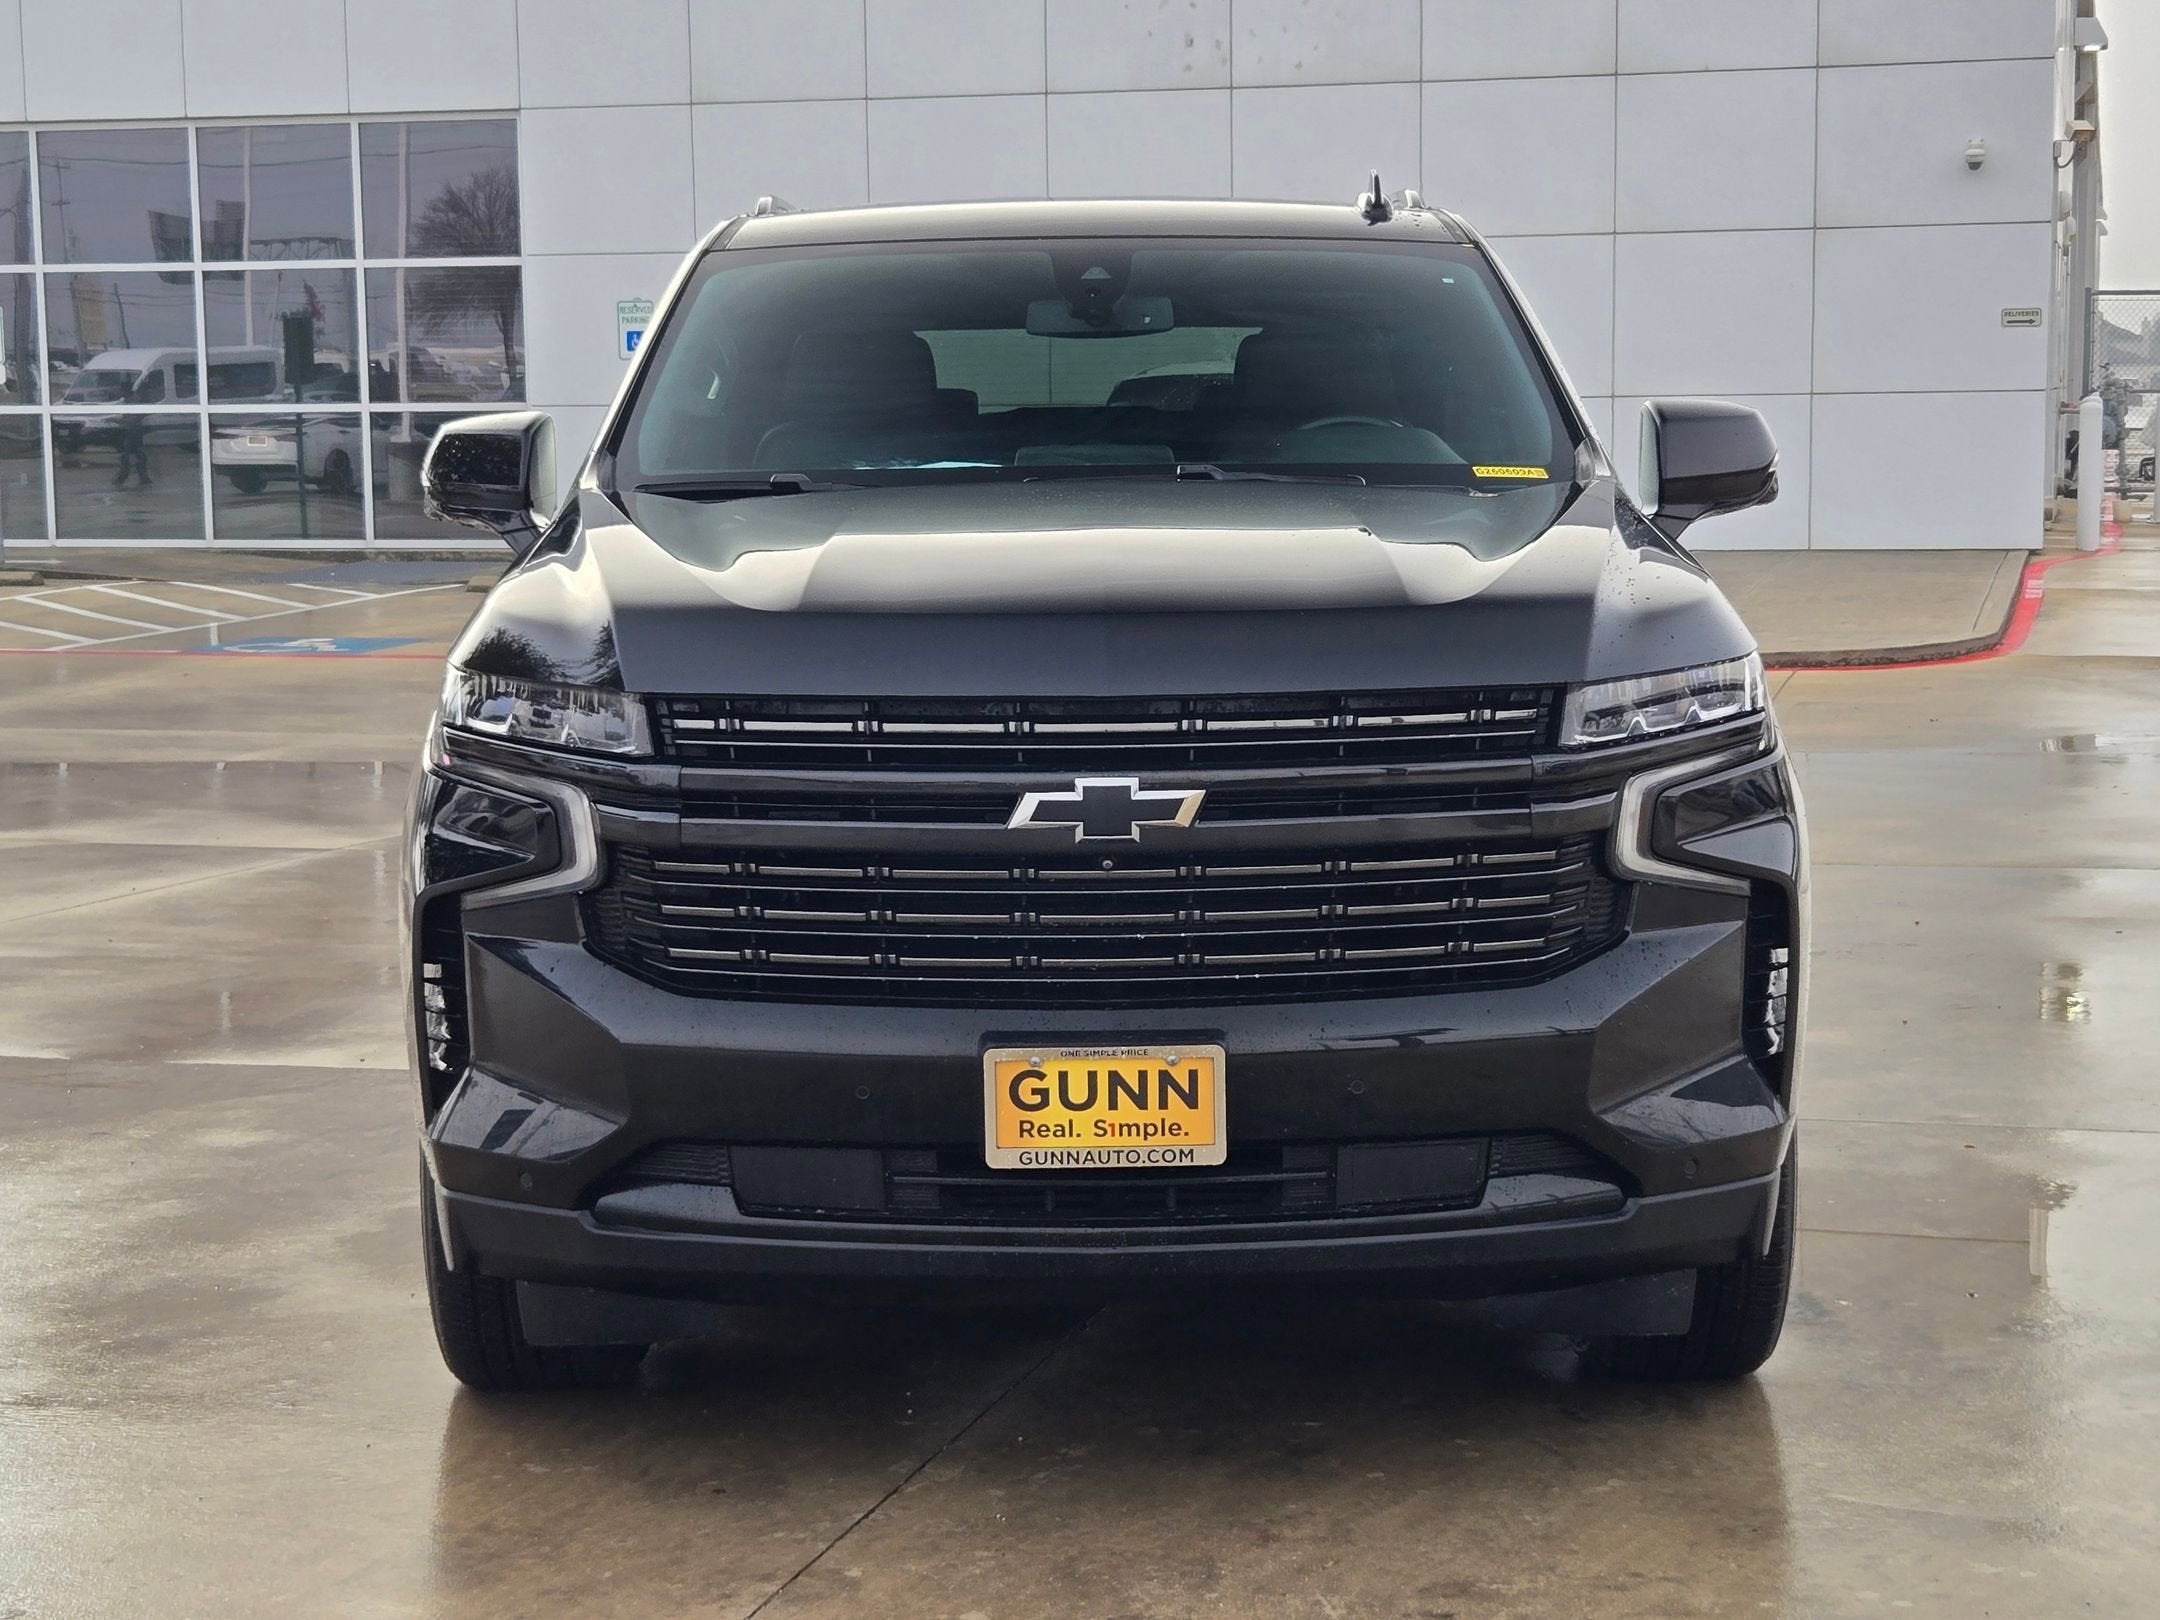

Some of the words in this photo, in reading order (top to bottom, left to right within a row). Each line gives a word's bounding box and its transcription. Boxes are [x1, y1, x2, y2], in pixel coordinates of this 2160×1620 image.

[620, 305, 652, 314] RESERVED
[1060, 1049, 1081, 1057] ONE
[1084, 1049, 1117, 1057] SIMPLE
[1121, 1048, 1149, 1056] PRICE
[1009, 1069, 1199, 1112] GUNN
[1019, 1119, 1081, 1138] Real.
[1019, 1149, 1194, 1166] GUNNAUTO.COM
